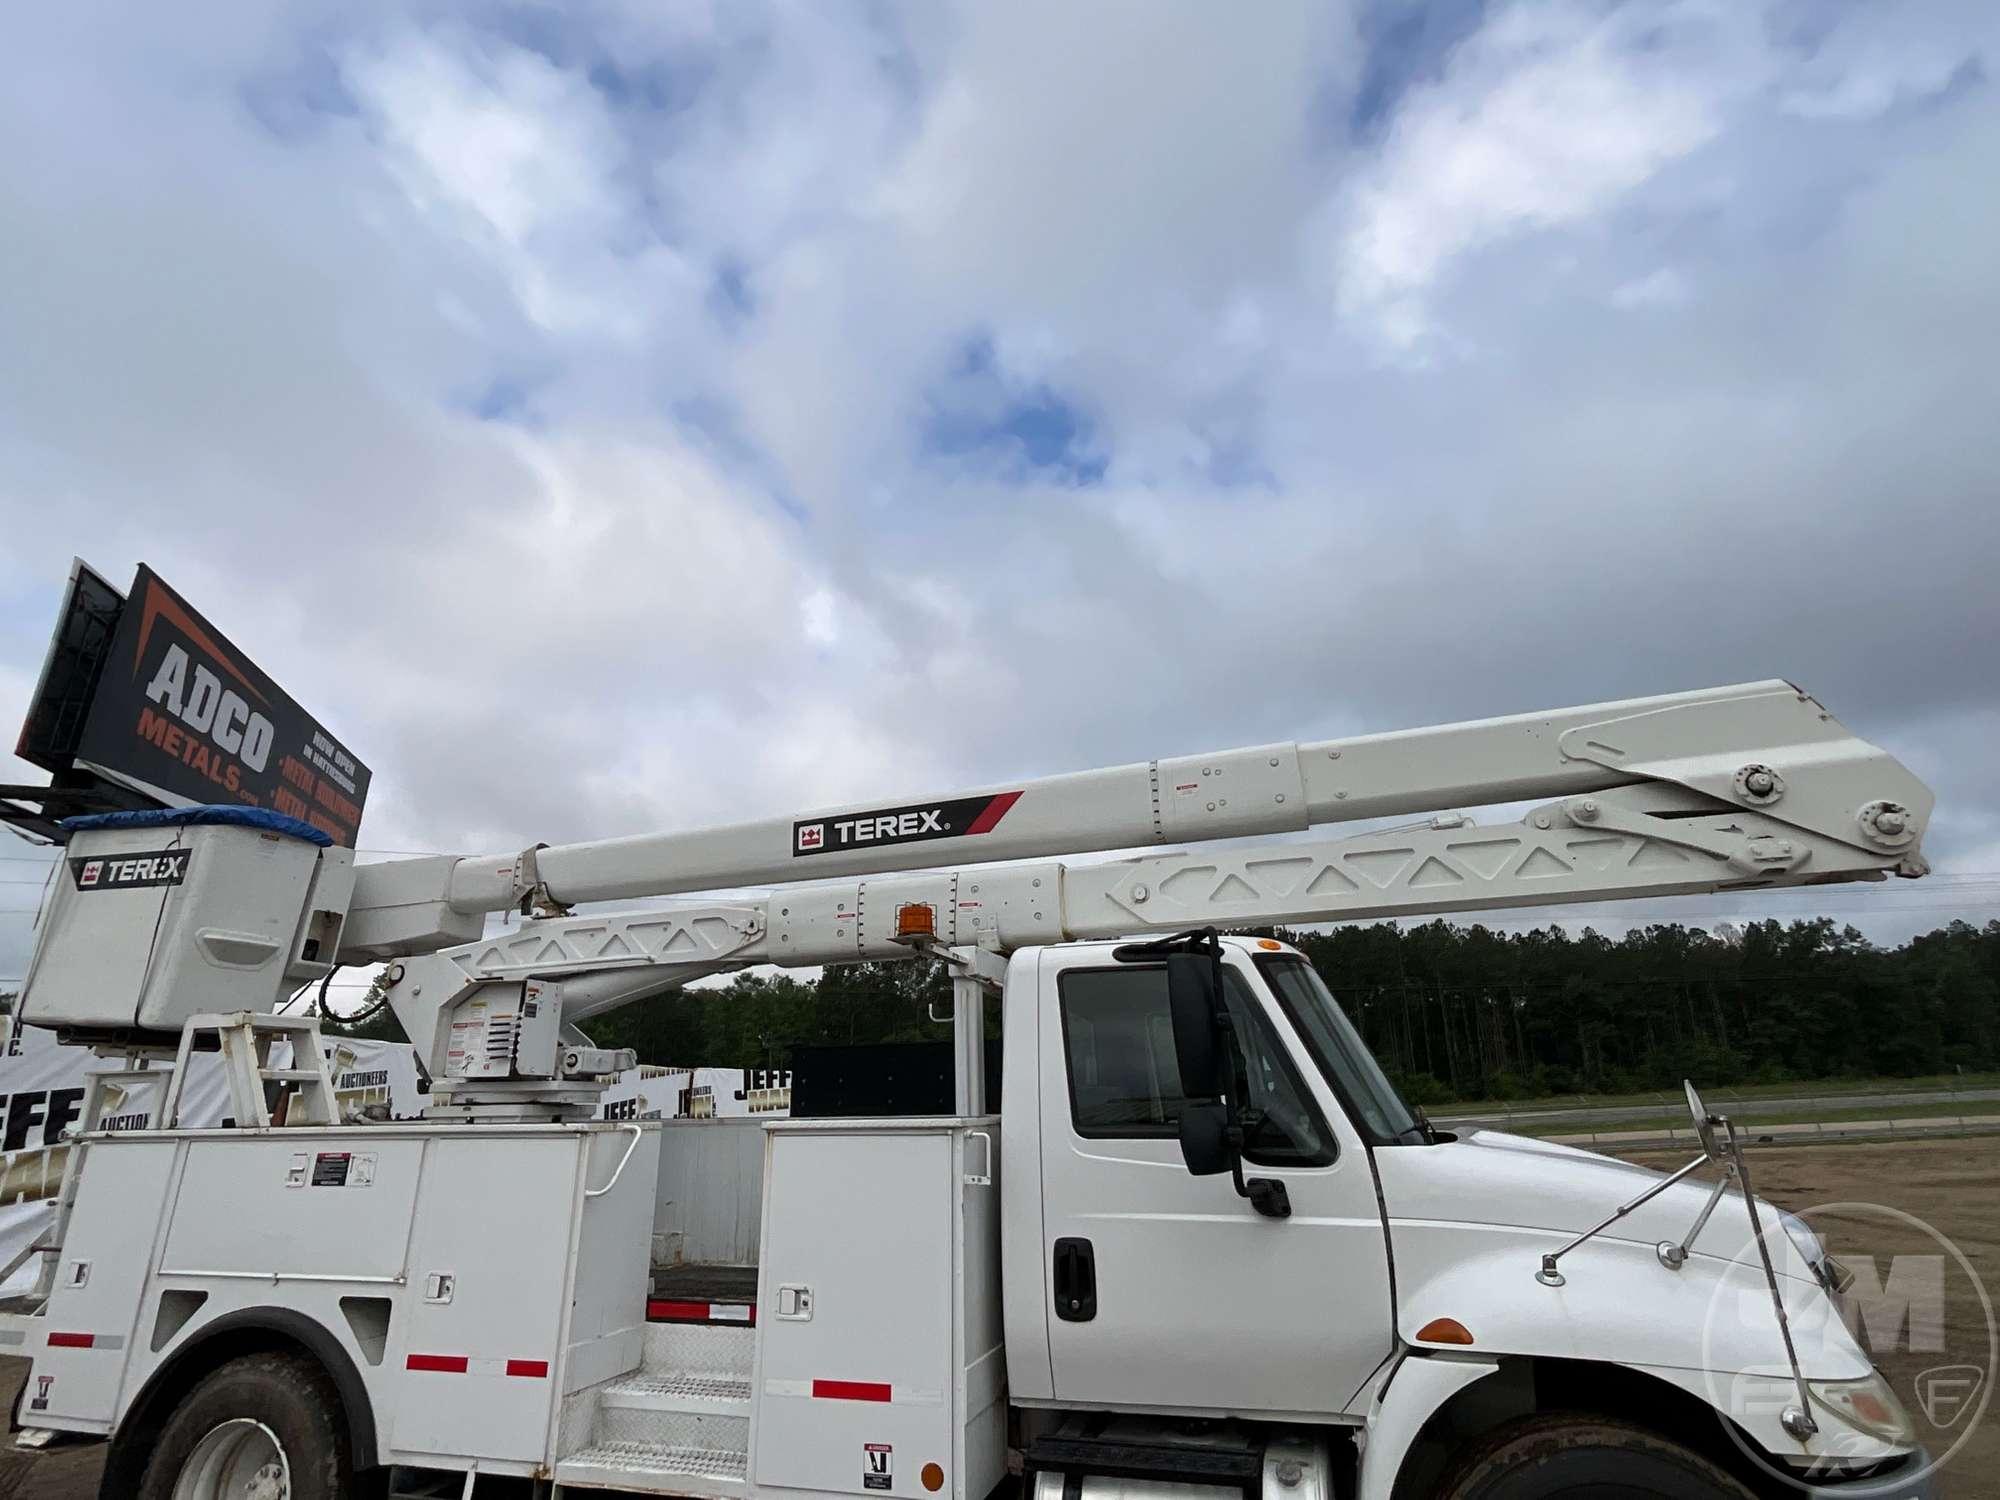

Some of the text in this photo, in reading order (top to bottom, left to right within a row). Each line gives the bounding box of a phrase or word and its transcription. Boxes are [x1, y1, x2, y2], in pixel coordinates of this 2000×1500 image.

[146, 643, 275, 774] ADCO
[137, 707, 241, 793] METALS
[834, 808, 943, 845] TEREX
[340, 1070, 388, 1089] AUCTIONEERS
[734, 1069, 792, 1101] JEFF
